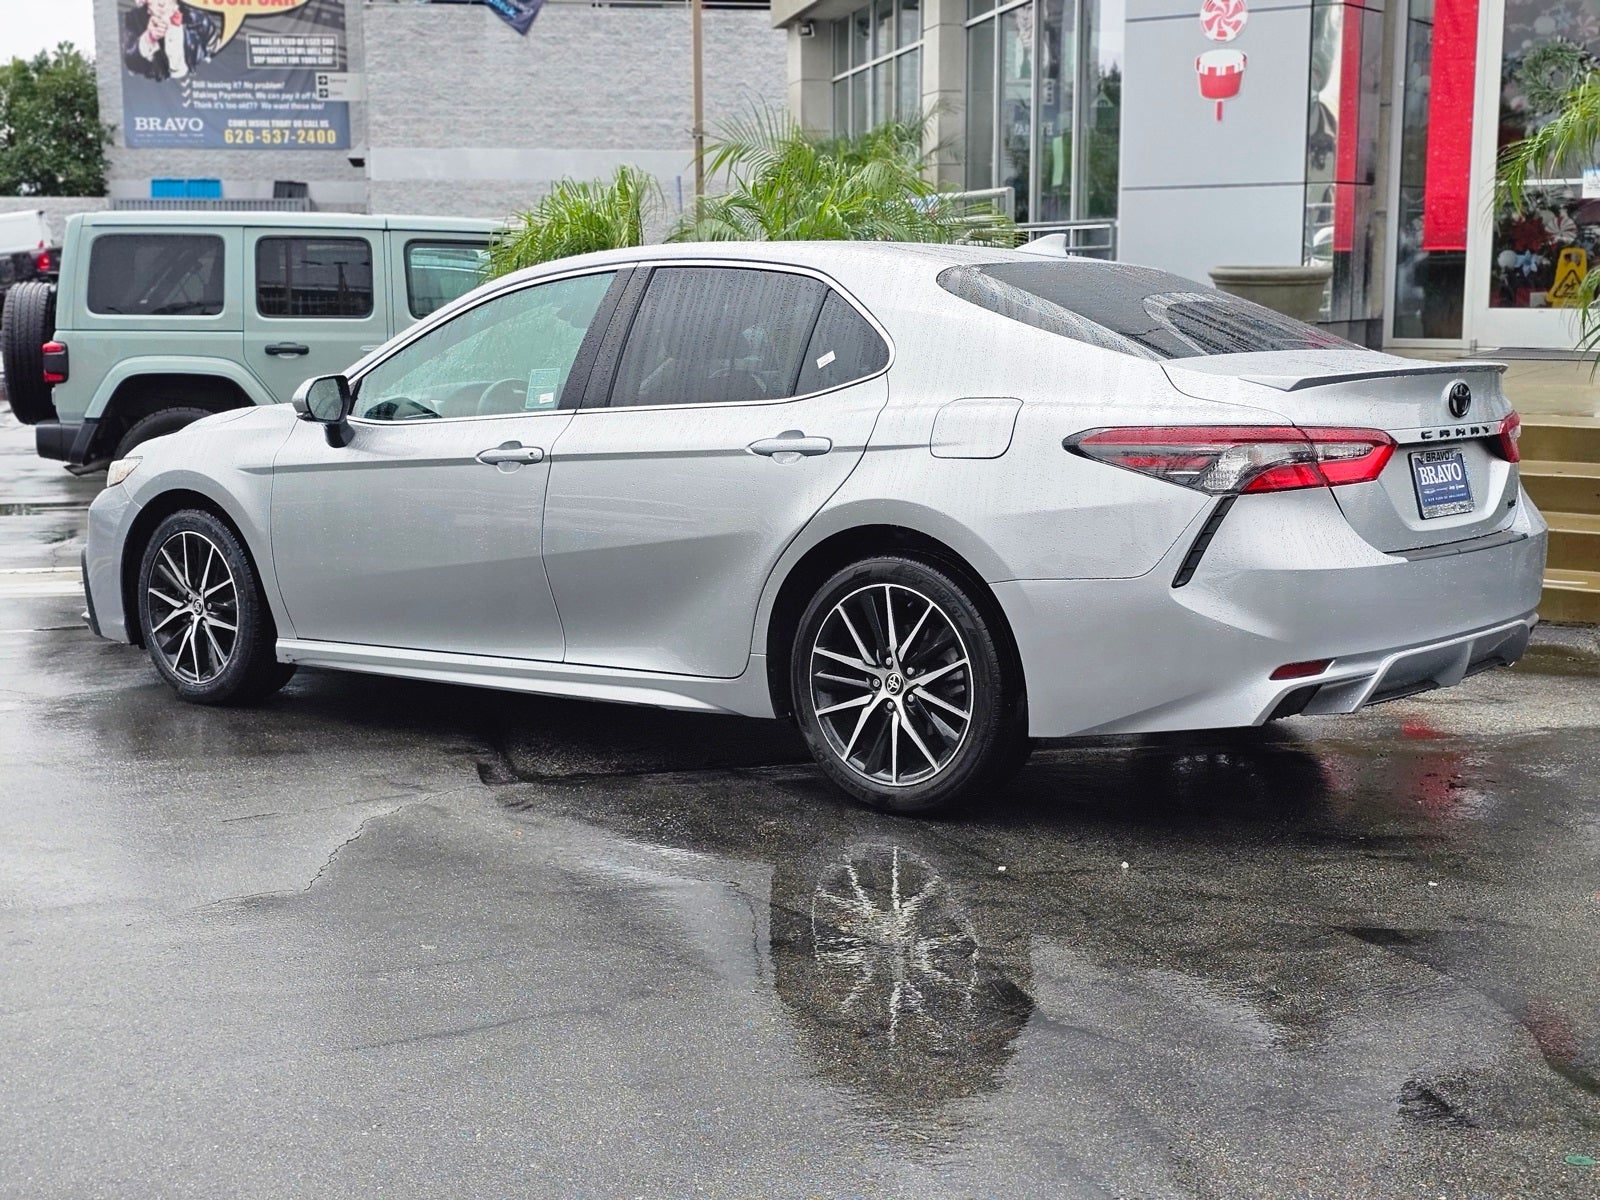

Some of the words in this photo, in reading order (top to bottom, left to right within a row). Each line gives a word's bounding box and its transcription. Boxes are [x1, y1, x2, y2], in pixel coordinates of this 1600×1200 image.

[192, 80, 206, 89] Still
[207, 81, 232, 91] leasing
[243, 81, 254, 89] No
[192, 90, 218, 101] Making
[281, 93, 294, 101] pay
[301, 91, 312, 100] off
[193, 101, 213, 109] Think
[290, 102, 310, 110] those
[133, 117, 204, 131] BRAVO
[227, 119, 247, 128] COME
[247, 119, 271, 128] INSIDE
[271, 119, 292, 128] TODAY
[292, 119, 303, 128] OR
[303, 119, 319, 128] CALL
[319, 119, 330, 128] US
[224, 129, 337, 144] 626-537-2400
[1420, 426, 1490, 440] CAMRY
[1425, 450, 1450, 462] BRAVO
[1418, 462, 1462, 485] BRAVO
